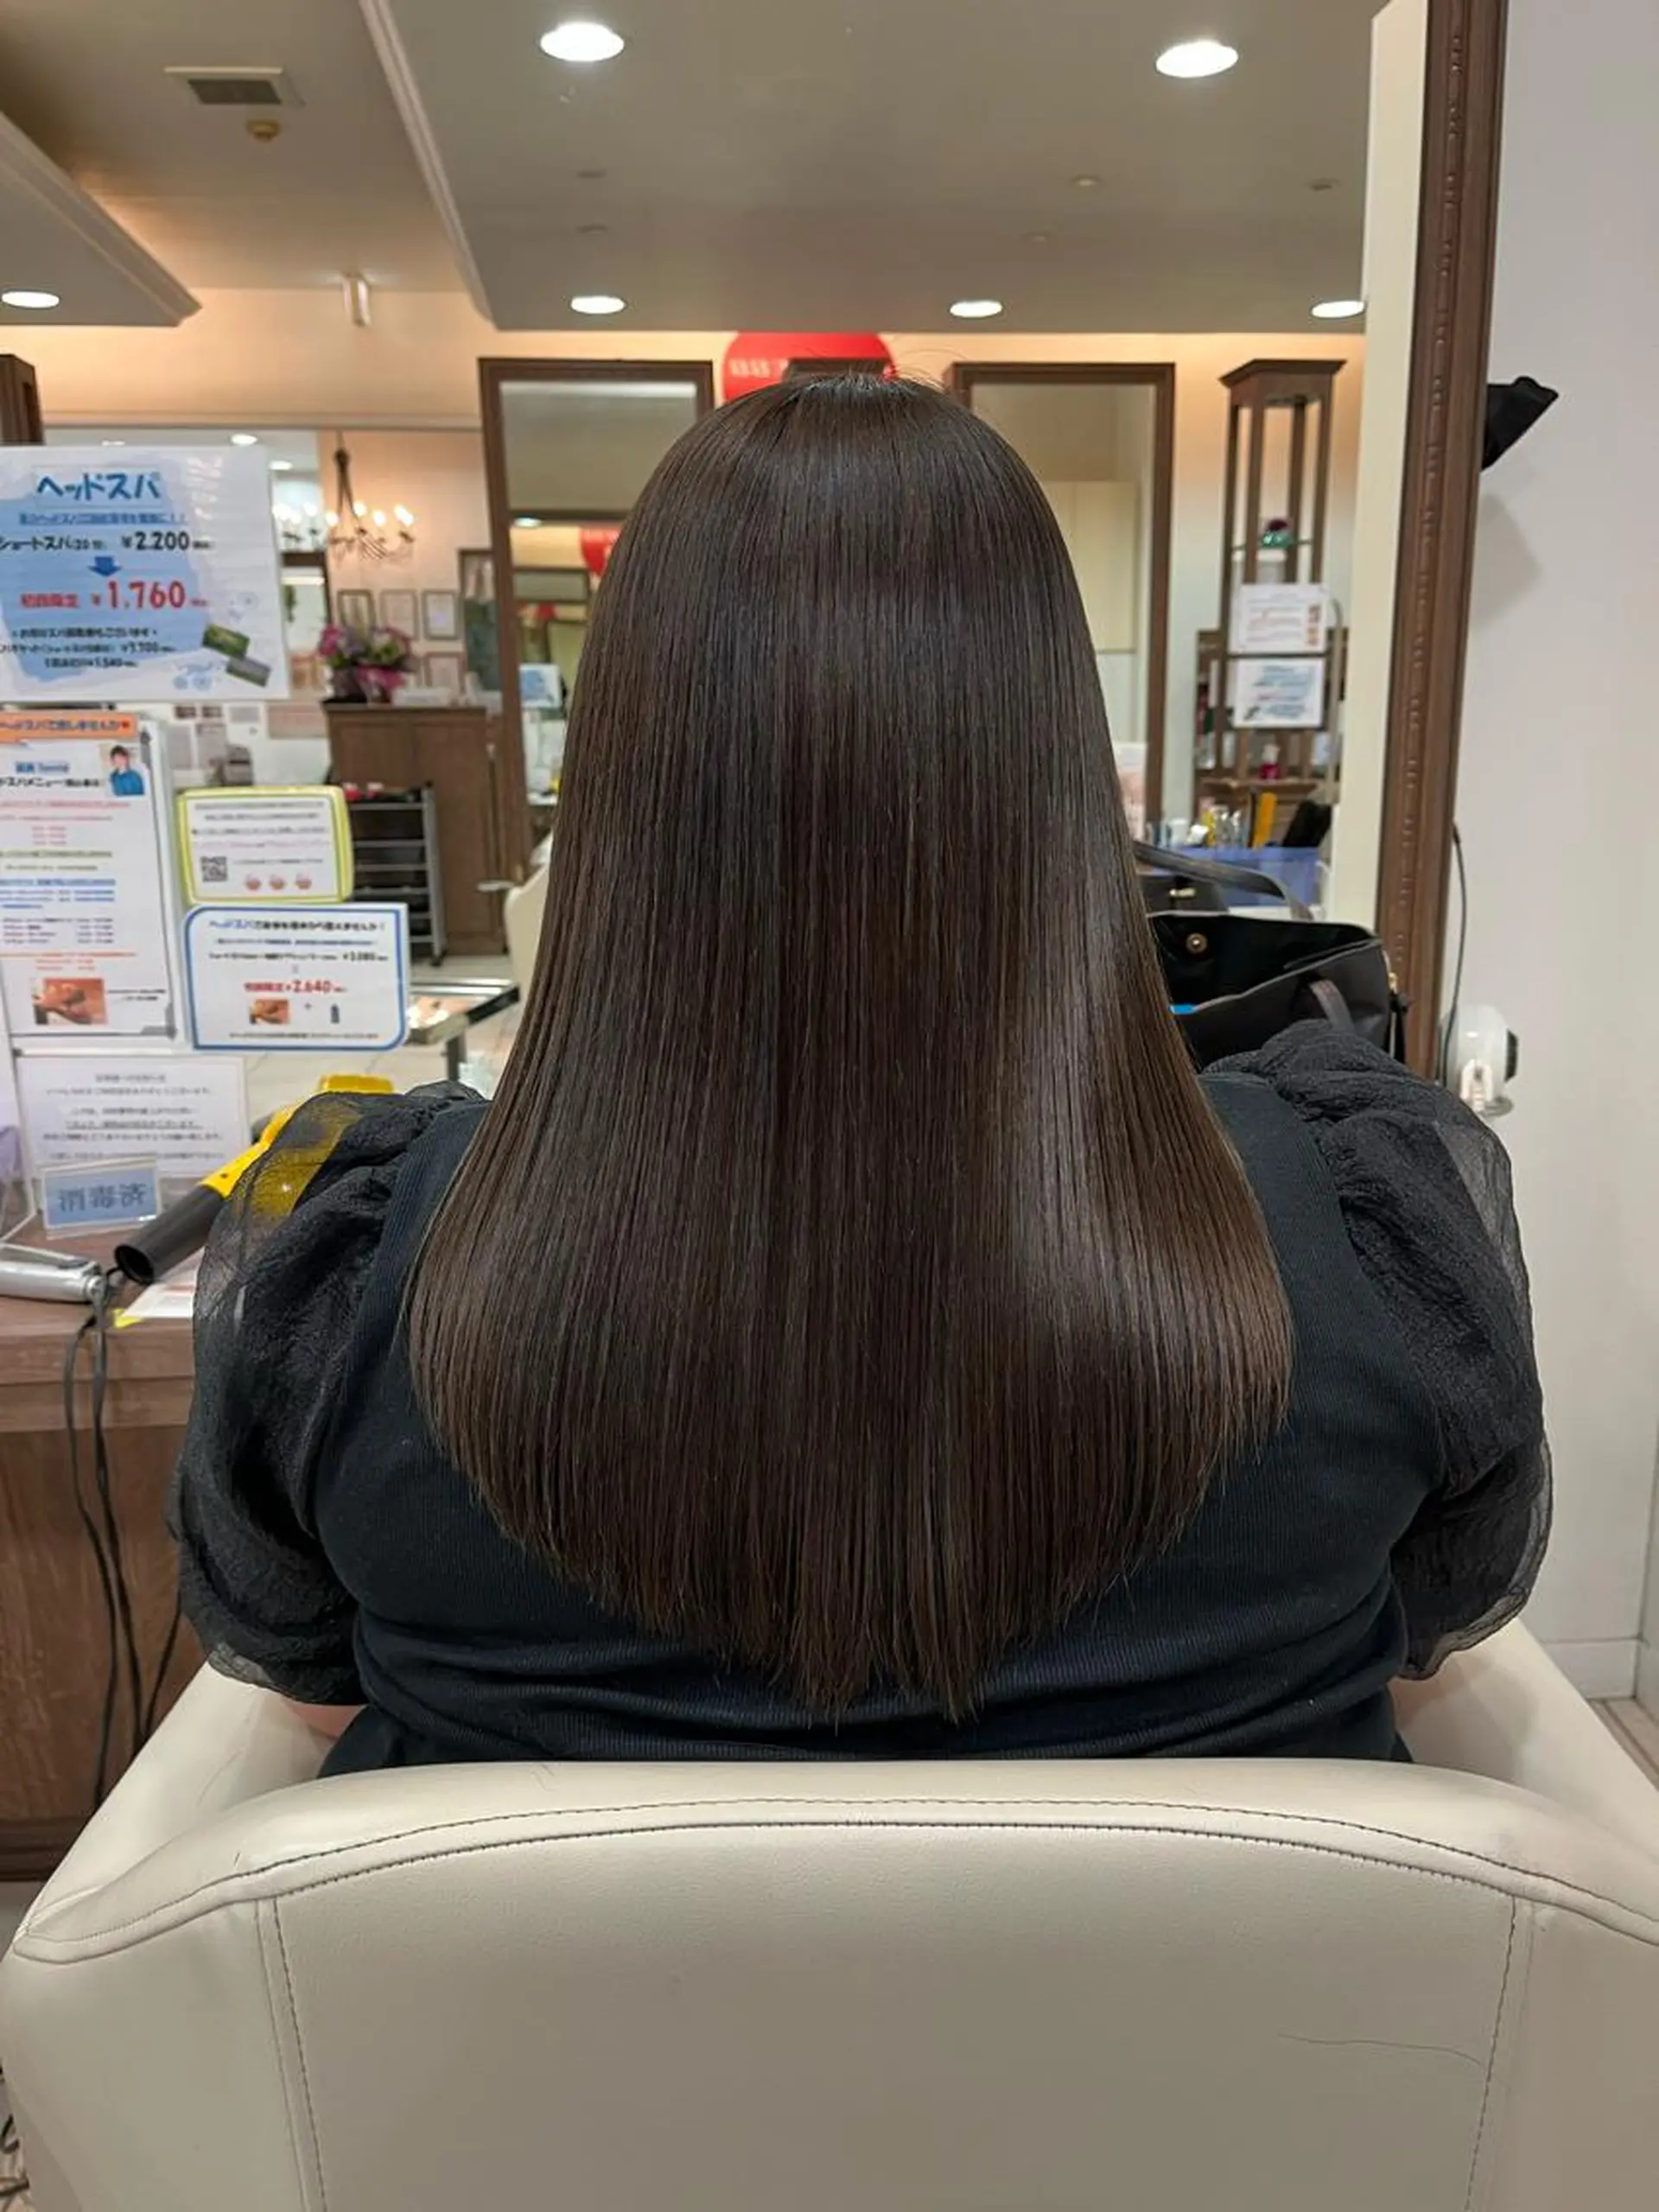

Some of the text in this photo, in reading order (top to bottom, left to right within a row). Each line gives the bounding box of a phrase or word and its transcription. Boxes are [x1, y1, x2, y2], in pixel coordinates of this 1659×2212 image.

[36, 472, 162, 500] ヘッドスパ
[59, 1182, 147, 1213] 消毒済
